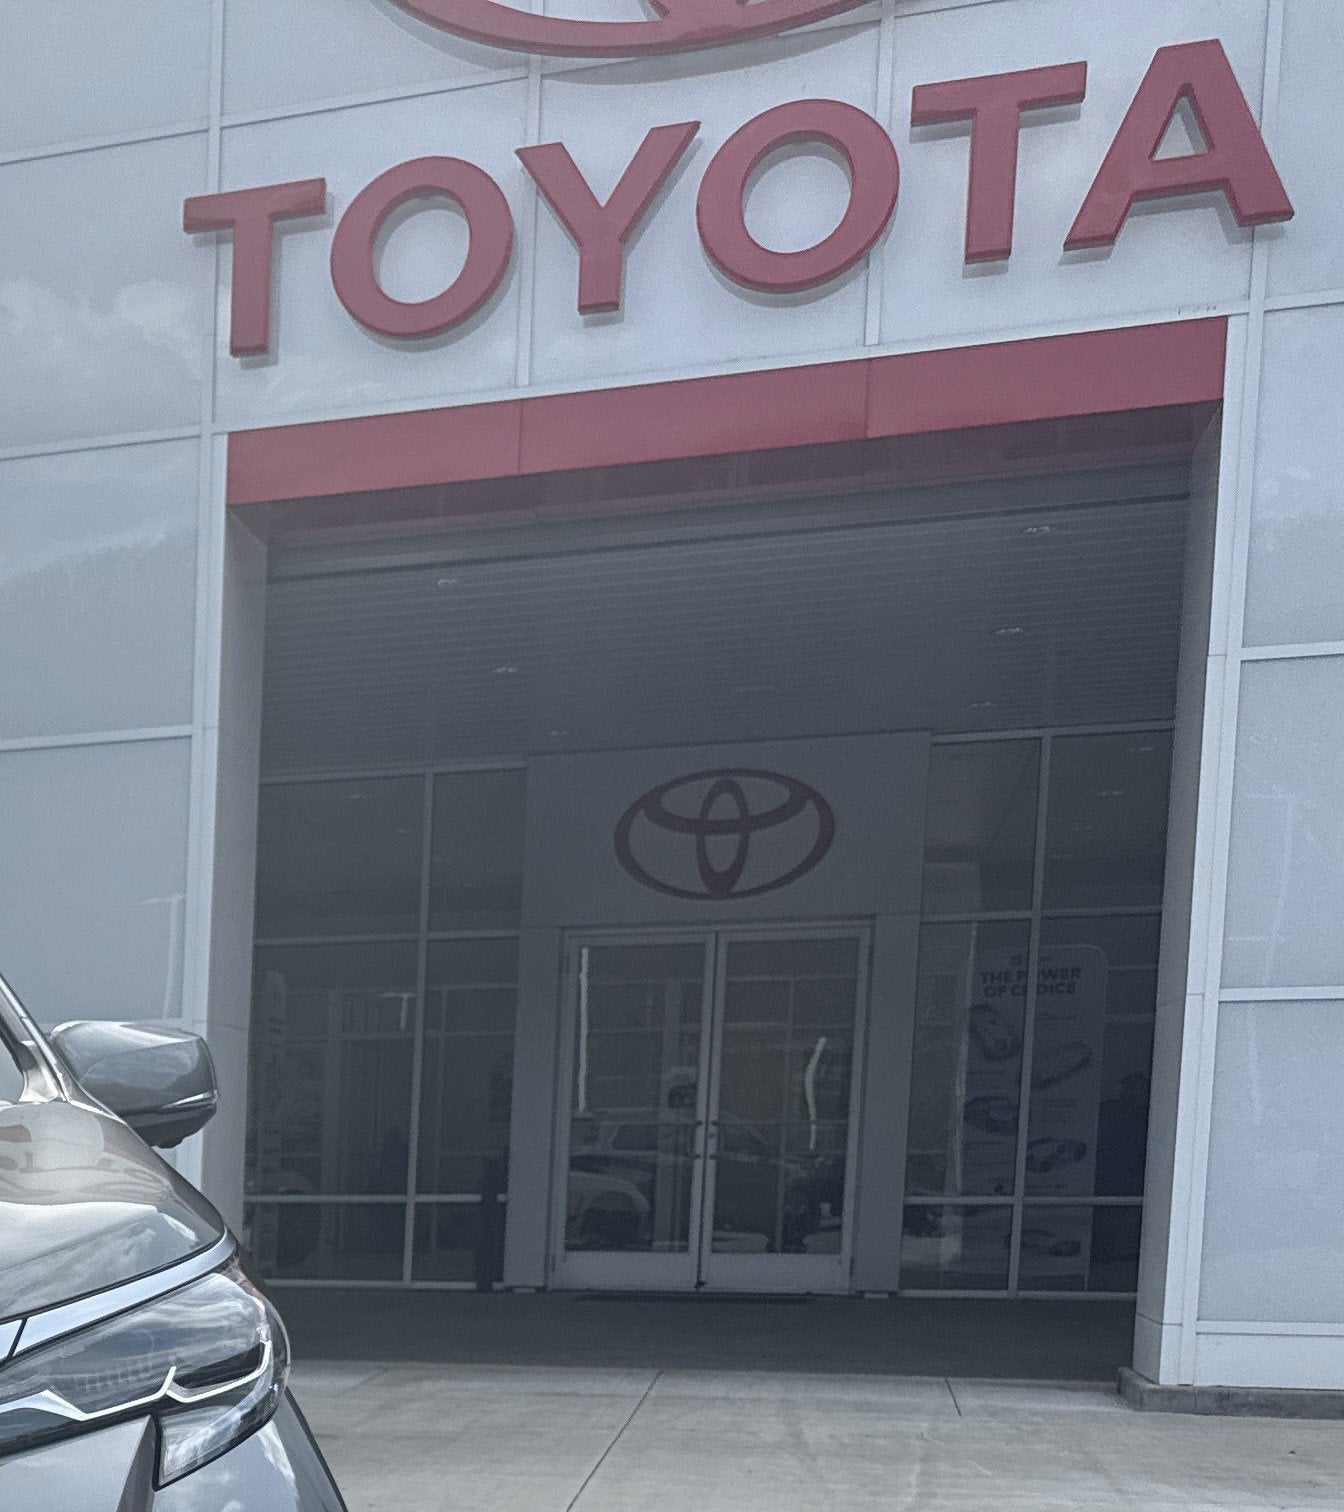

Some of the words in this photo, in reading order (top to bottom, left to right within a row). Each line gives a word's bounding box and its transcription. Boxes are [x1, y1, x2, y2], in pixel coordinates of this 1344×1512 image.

[183, 38, 1294, 358] TOYOTA
[981, 970, 1012, 983] THE
[1017, 967, 1082, 981] PWER
[984, 985, 1007, 997] OF
